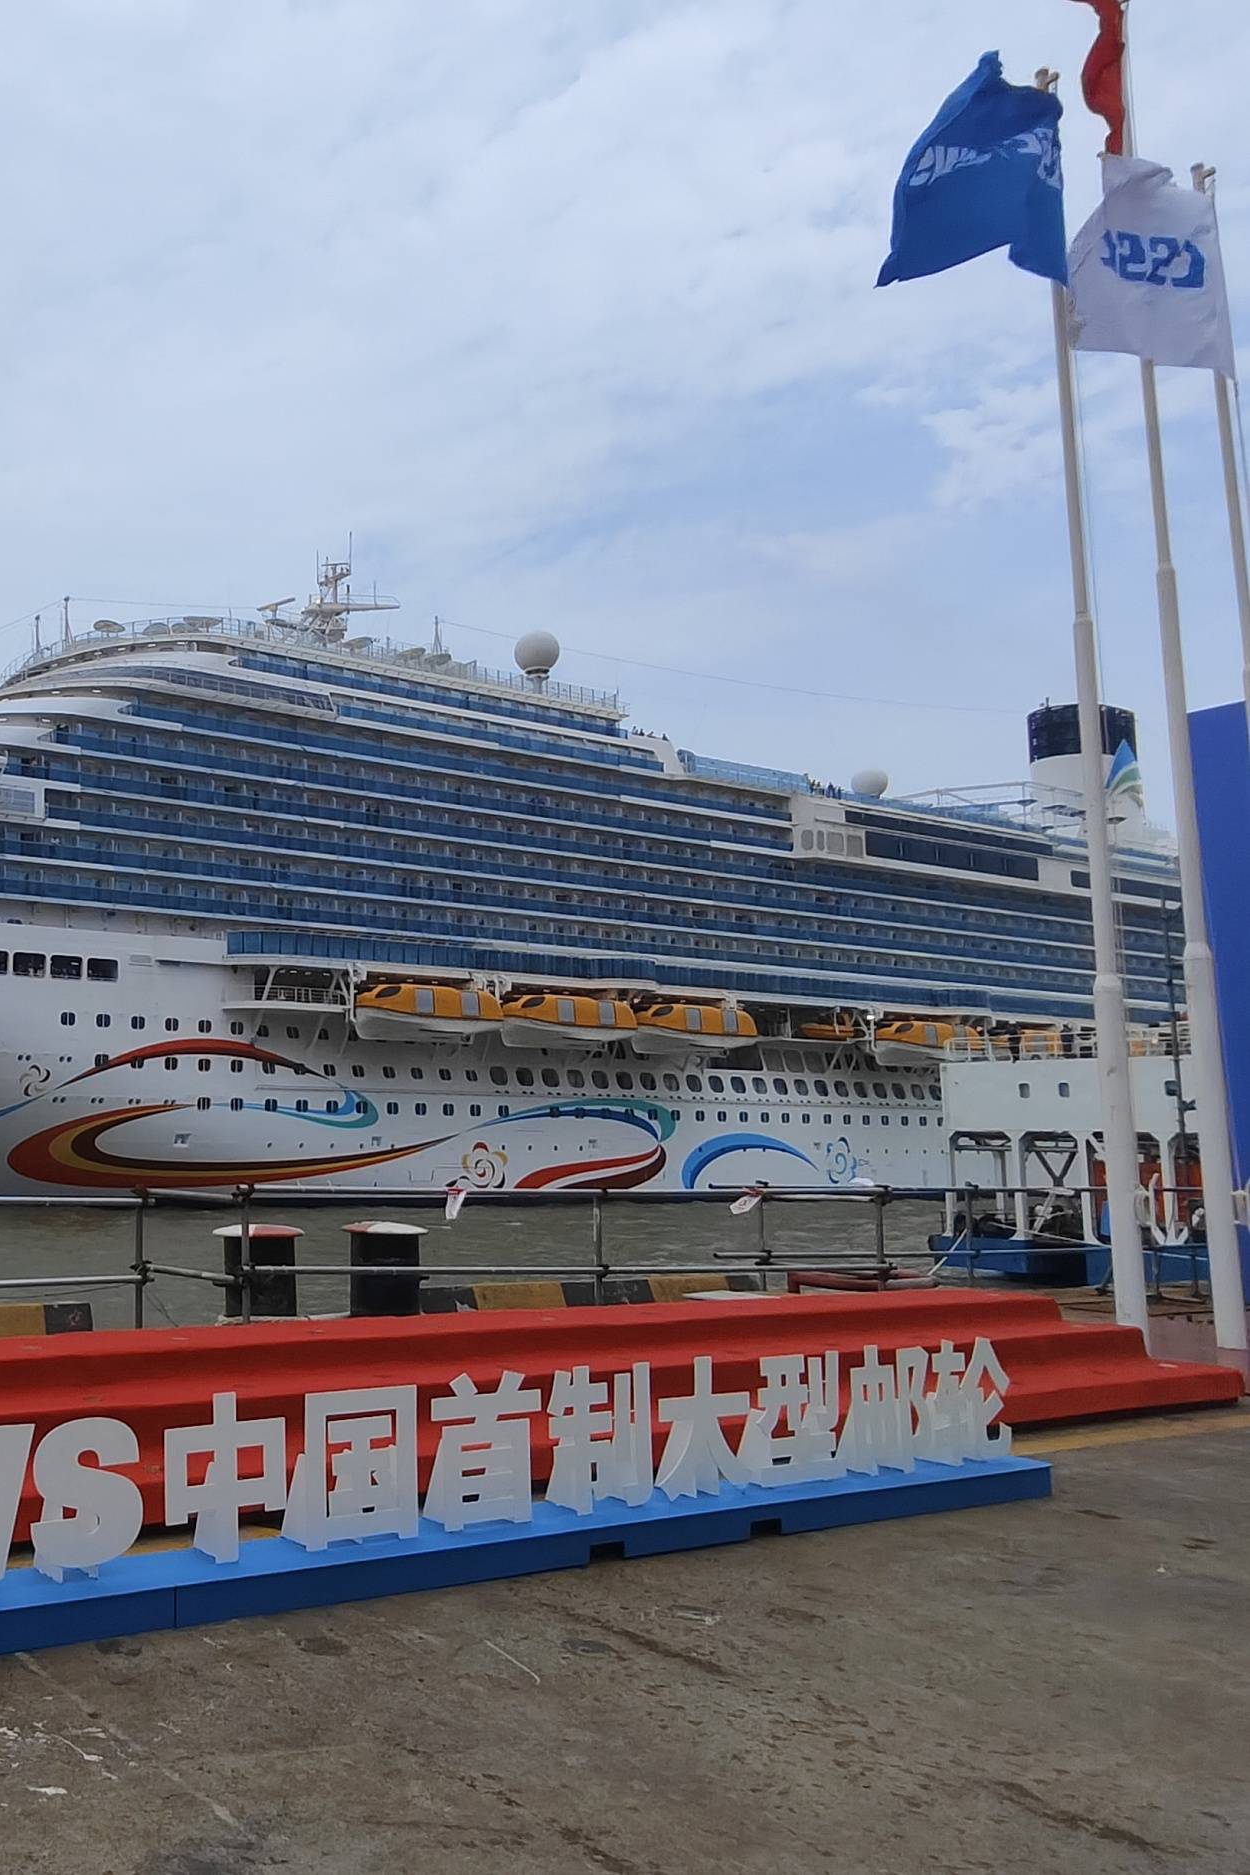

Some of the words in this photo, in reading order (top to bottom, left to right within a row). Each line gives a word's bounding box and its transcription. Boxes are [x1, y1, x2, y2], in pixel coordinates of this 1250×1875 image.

[163, 1337, 1013, 1566] 中国首制大型邮轮
